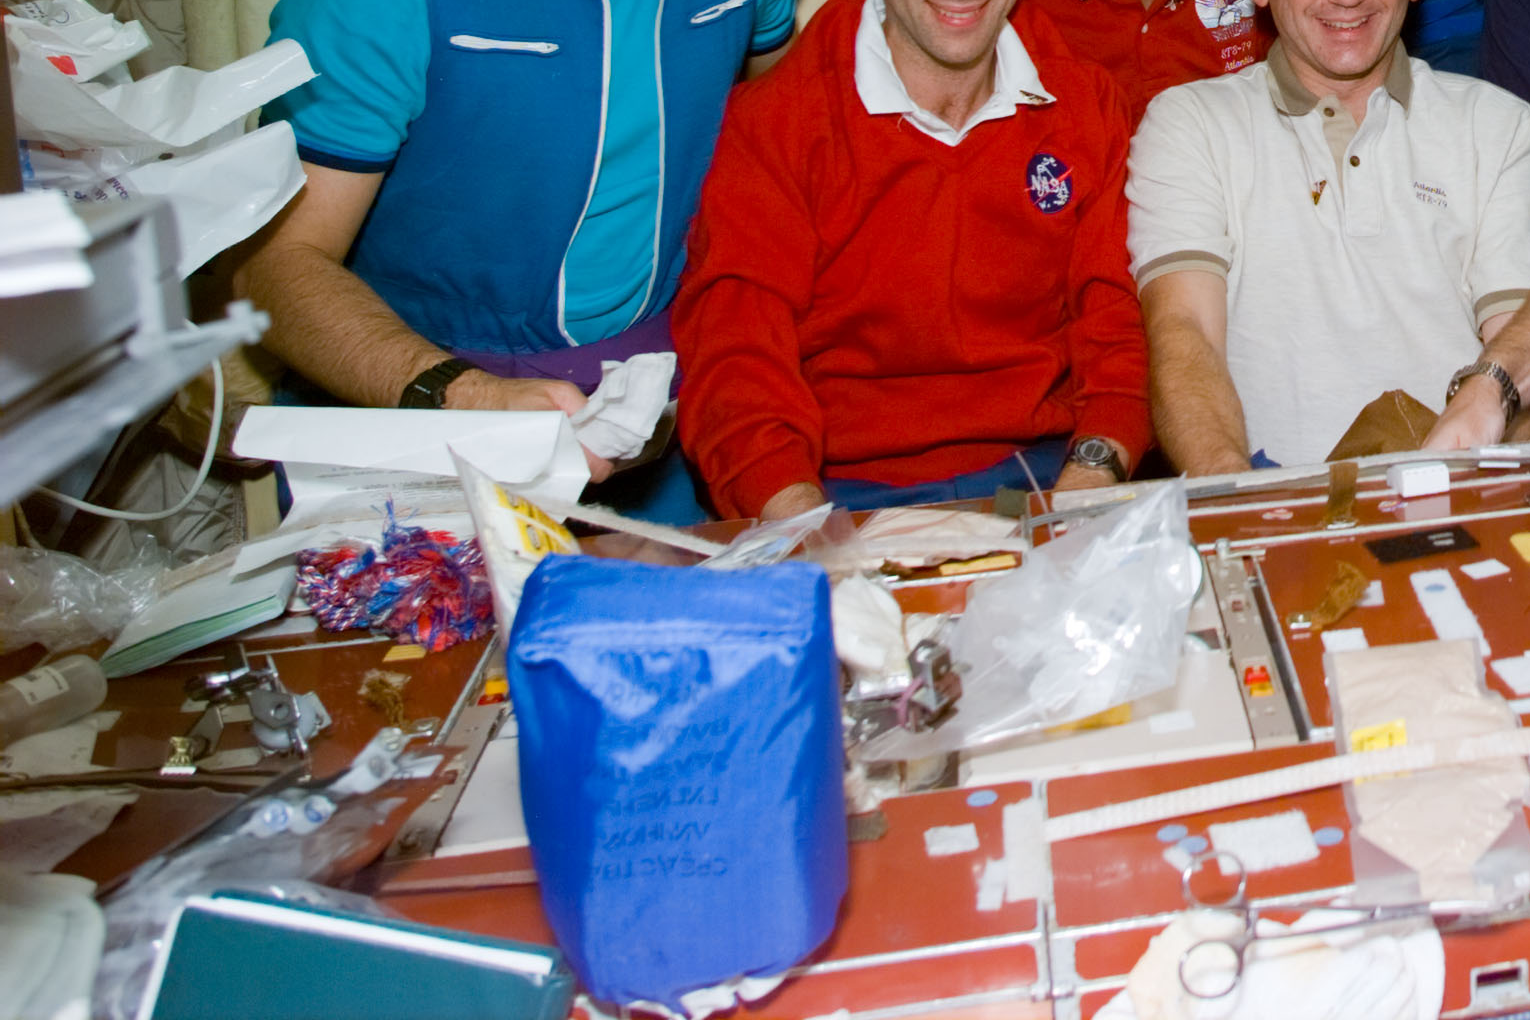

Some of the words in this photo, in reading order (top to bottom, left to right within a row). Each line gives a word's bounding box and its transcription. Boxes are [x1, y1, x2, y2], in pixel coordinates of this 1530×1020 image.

[1221, 41, 1252, 59] STS-79
[1224, 55, 1254, 72] Atlantis
[1031, 173, 1070, 197] NASA
